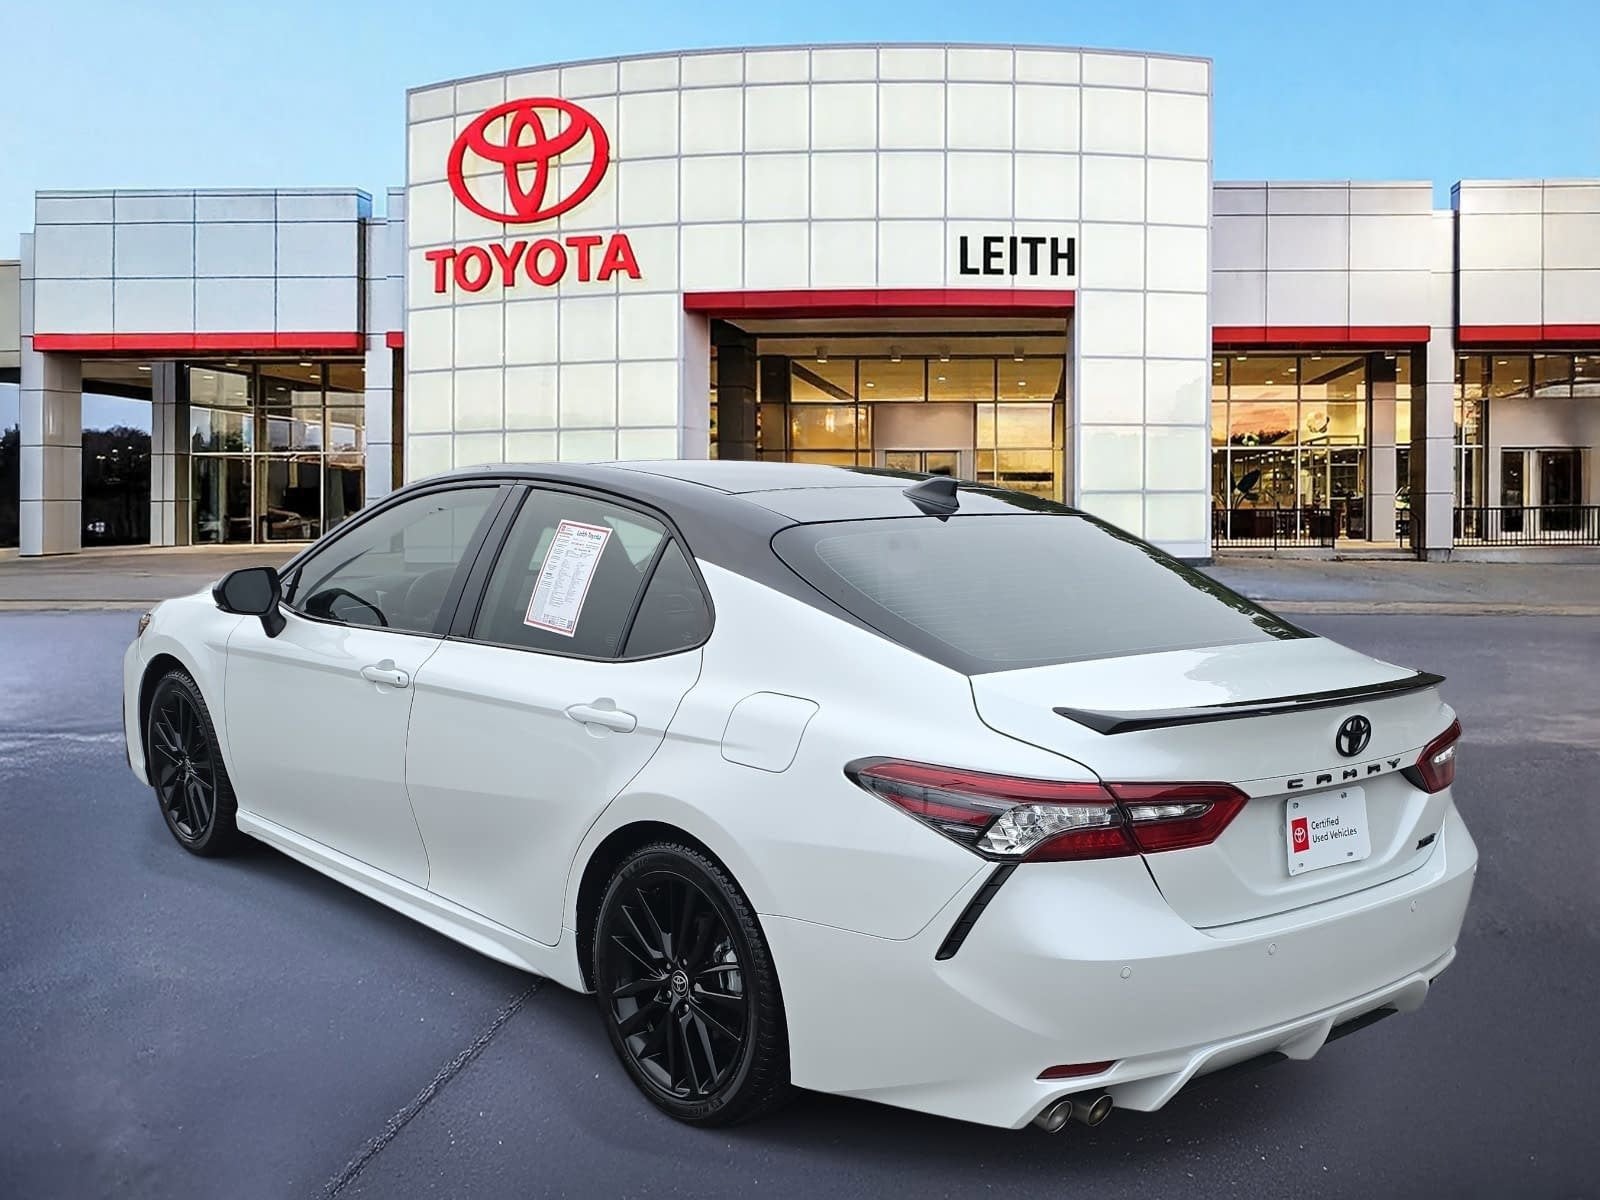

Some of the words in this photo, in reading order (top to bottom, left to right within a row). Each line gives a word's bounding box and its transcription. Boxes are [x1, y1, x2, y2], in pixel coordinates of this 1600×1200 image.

[425, 234, 641, 293] TOYOTA
[960, 236, 1075, 276] LEITH
[1287, 758, 1400, 789] CAMRY
[1311, 816, 1339, 830] Certified
[1312, 832, 1329, 843] Used
[1330, 827, 1358, 840] Vehicles
